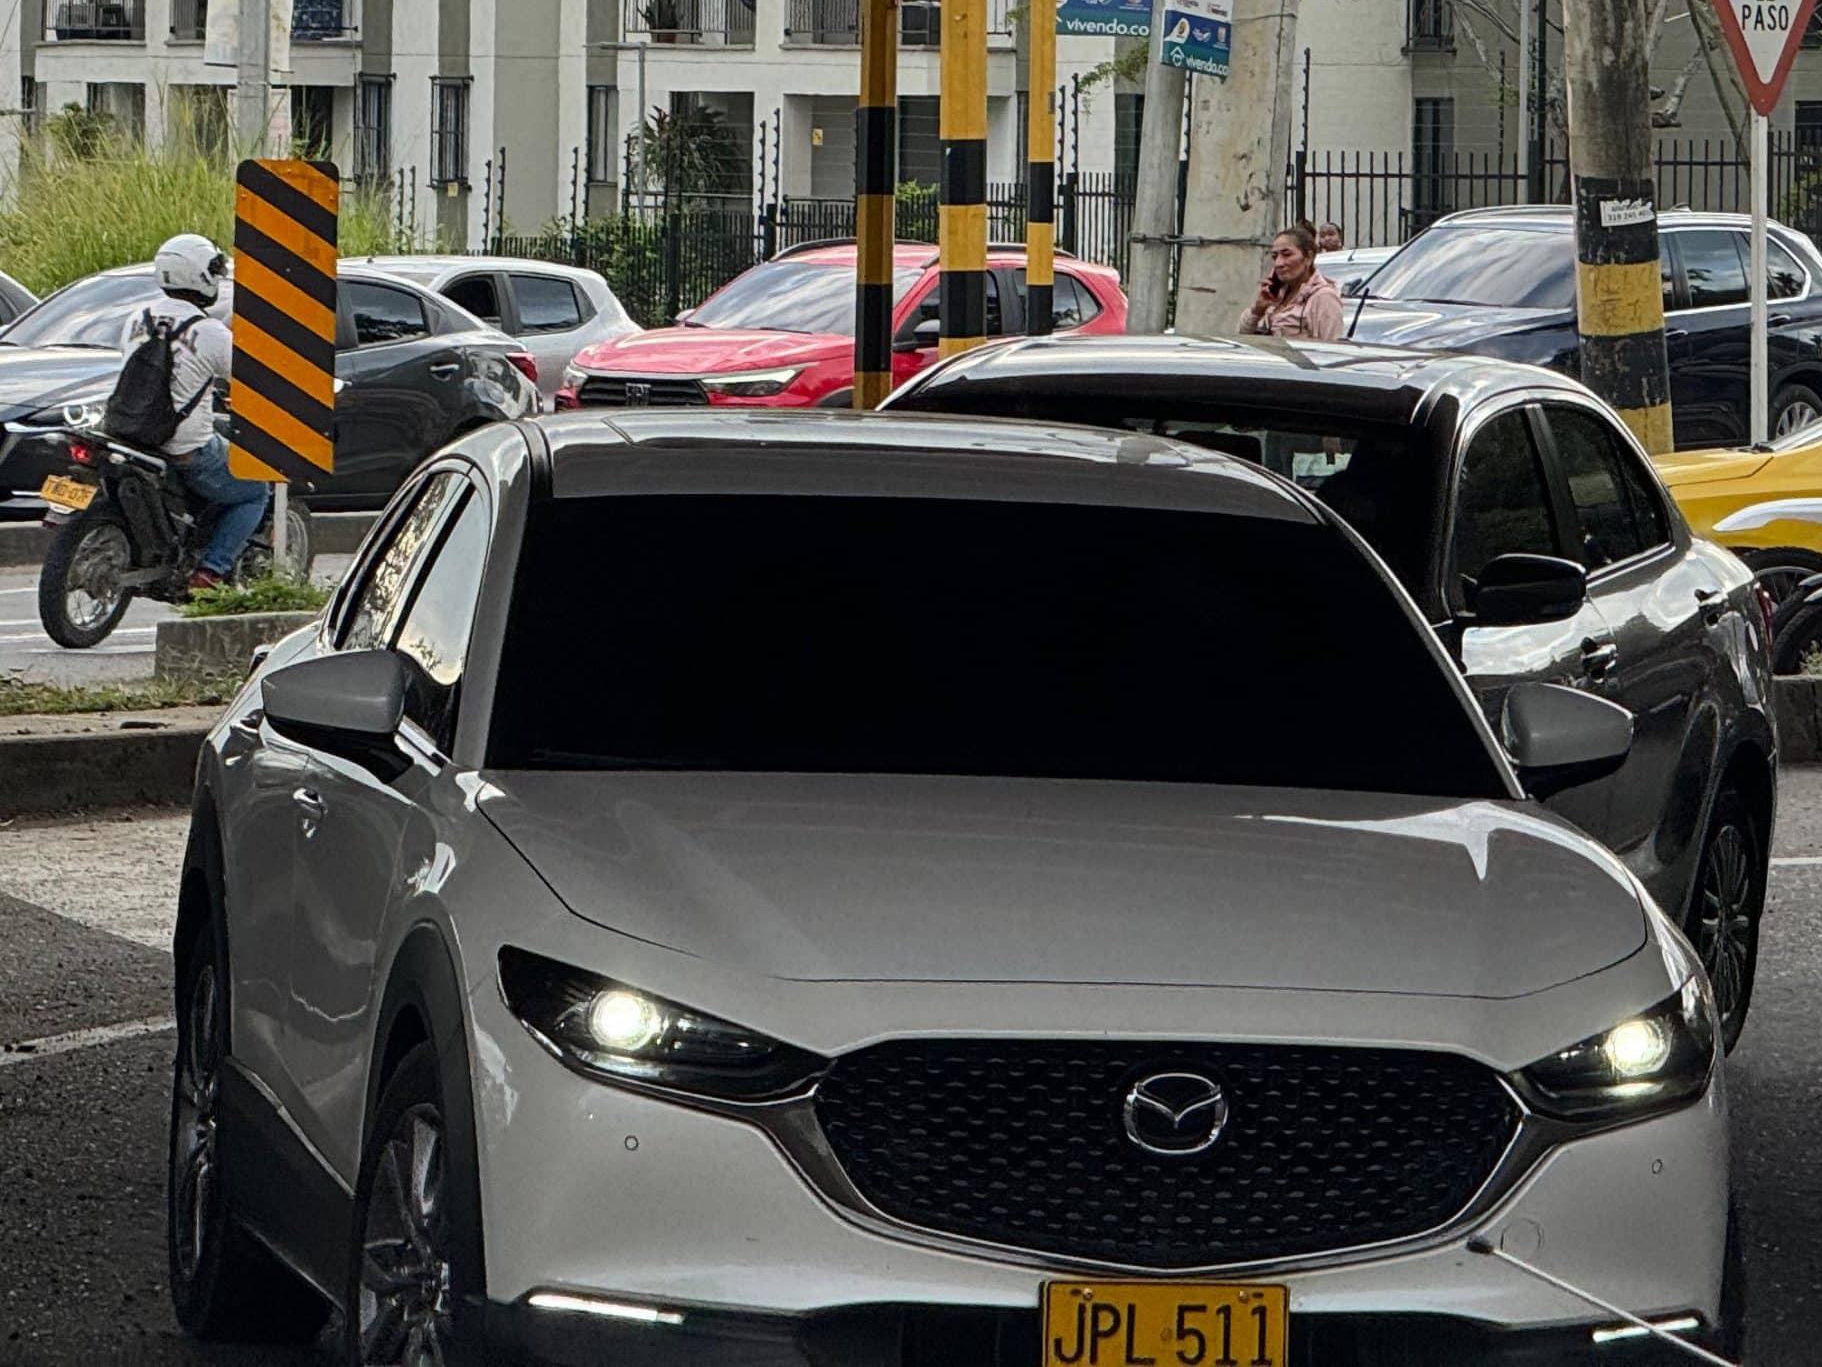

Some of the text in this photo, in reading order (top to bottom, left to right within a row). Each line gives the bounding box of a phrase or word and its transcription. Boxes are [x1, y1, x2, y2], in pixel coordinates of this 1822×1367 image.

[1066, 17, 1150, 36] vivendo.co
[1742, 4, 1789, 31] PASO
[1185, 57, 1229, 76] vivendo.co
[1053, 1302, 1272, 1366] JPL 511
